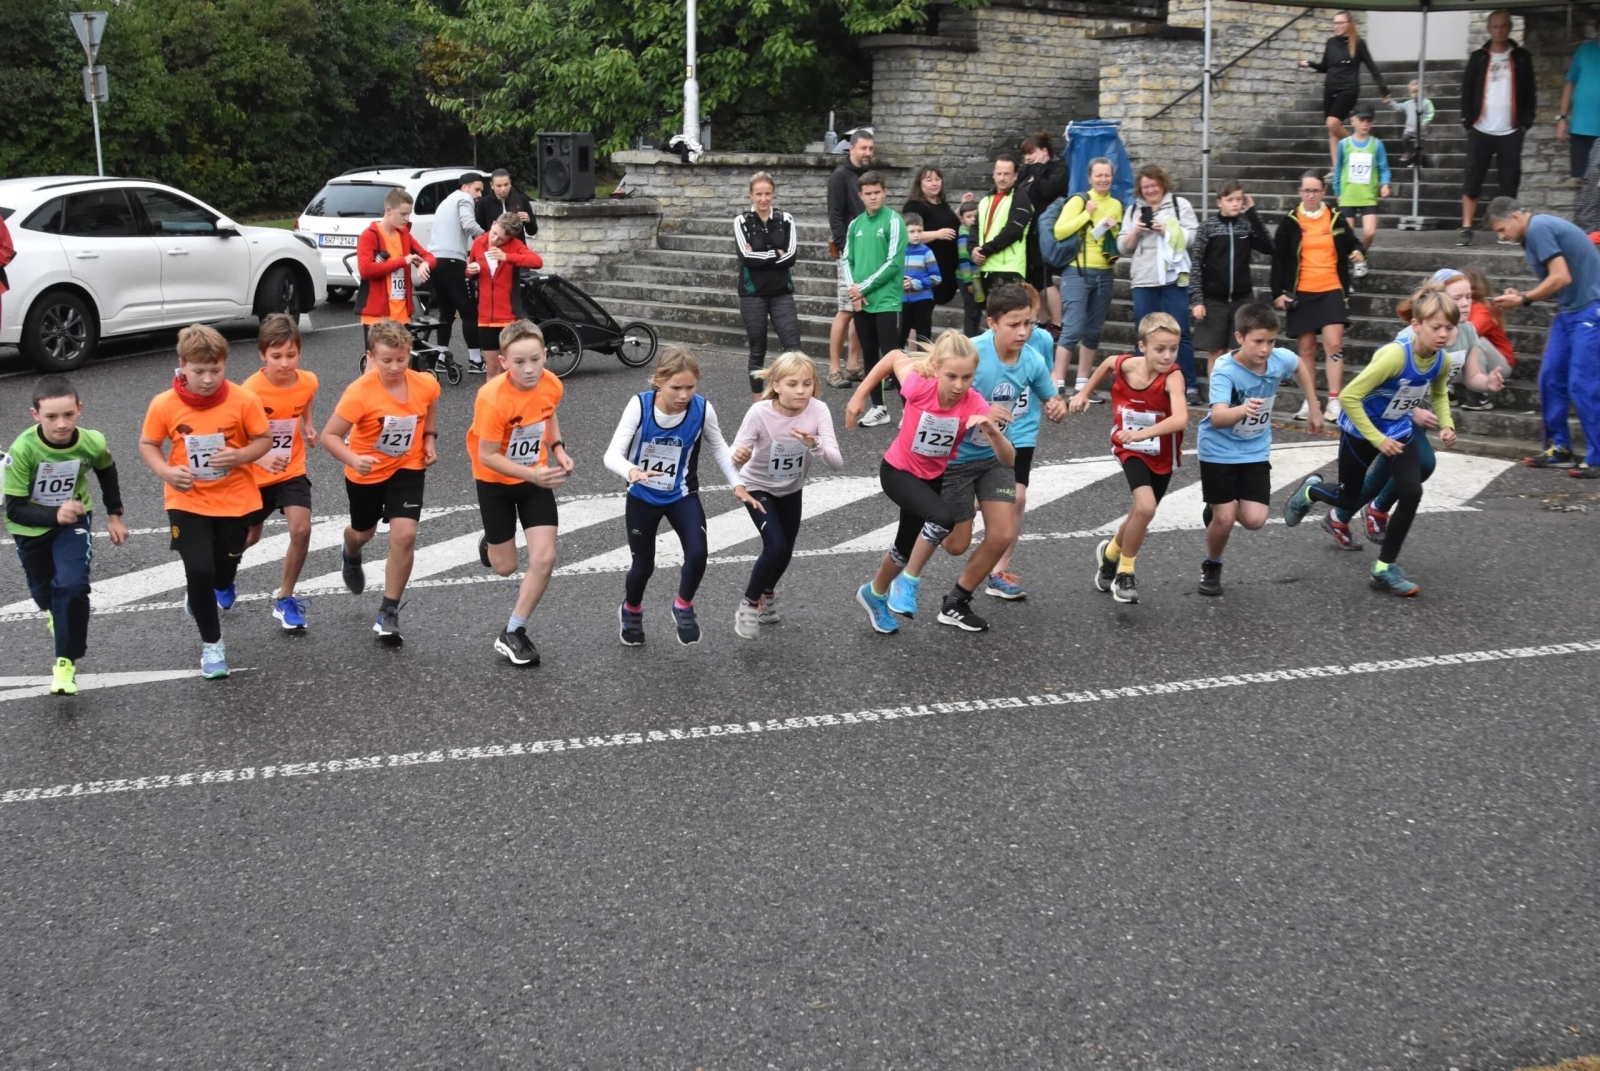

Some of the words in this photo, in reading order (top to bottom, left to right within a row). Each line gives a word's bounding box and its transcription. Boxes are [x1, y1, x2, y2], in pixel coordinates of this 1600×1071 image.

[1351, 164, 1371, 174] 107
[324, 236, 336, 244] 5H7
[1392, 398, 1420, 410] 139
[272, 435, 292, 449] 52
[382, 434, 412, 446] 121
[918, 431, 954, 447] 122
[510, 440, 540, 456] 104
[190, 454, 212, 468] 12
[641, 459, 676, 477] 144
[771, 456, 804, 470] 151
[38, 478, 74, 493] 105
